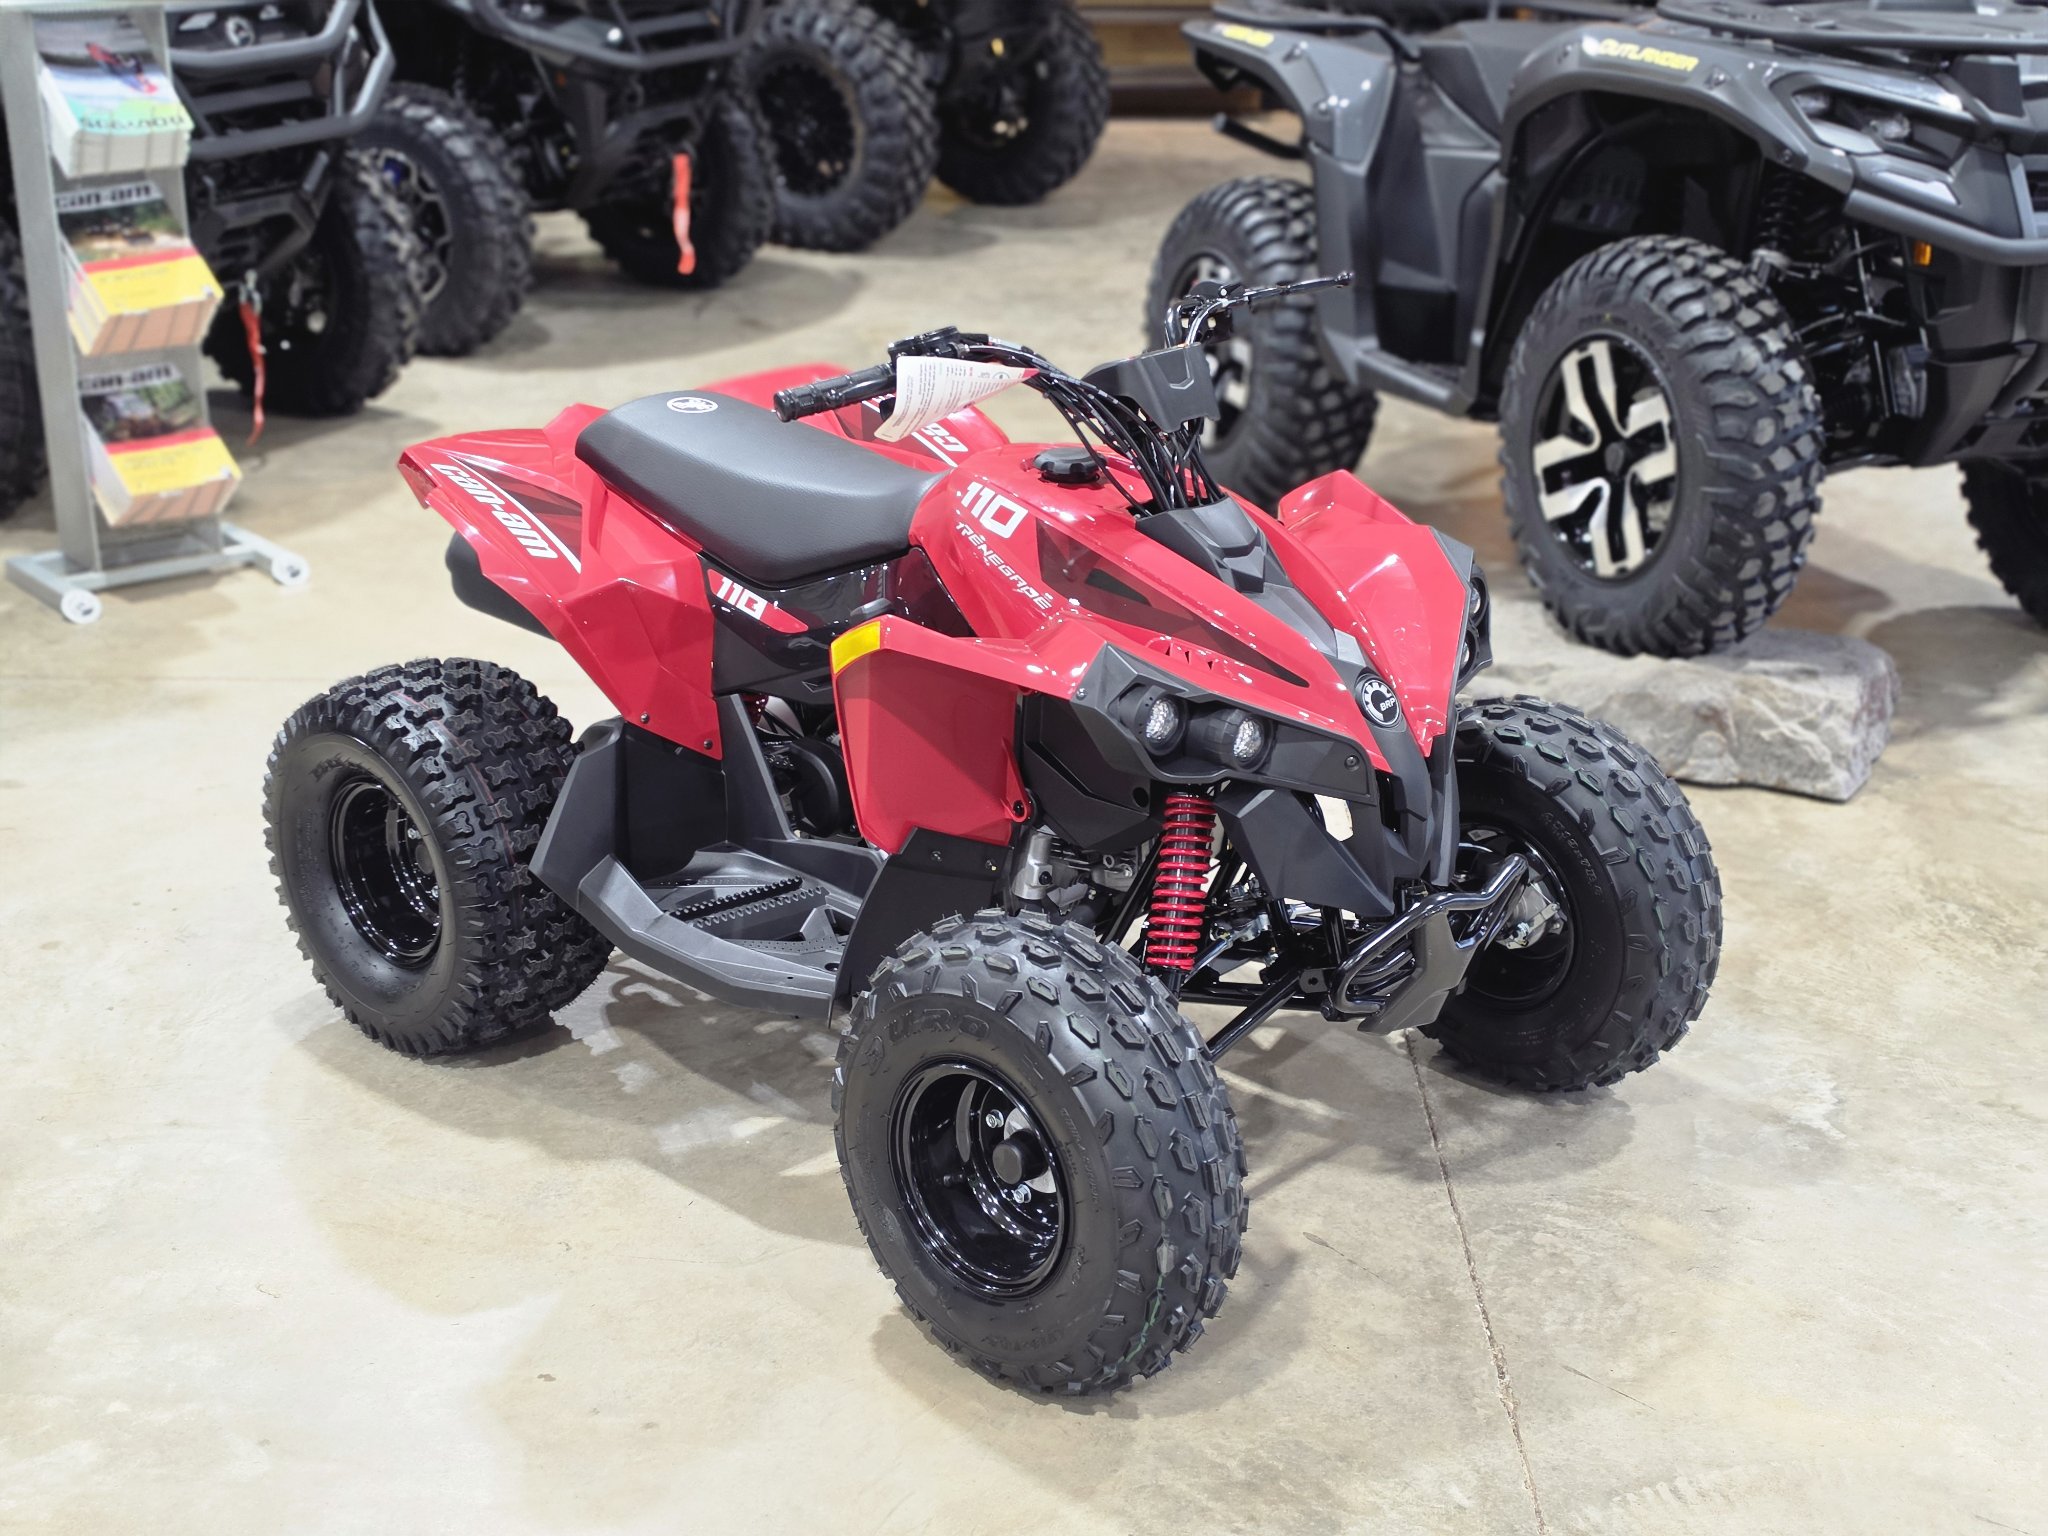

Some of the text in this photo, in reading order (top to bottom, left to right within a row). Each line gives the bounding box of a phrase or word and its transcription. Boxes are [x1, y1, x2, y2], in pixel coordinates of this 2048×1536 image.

[1600, 38, 1699, 72] OUTLANDER
[430, 463, 559, 559] can-am
[960, 481, 1029, 539] 110
[716, 576, 768, 620] 110
[1379, 697, 1396, 712] BRP
